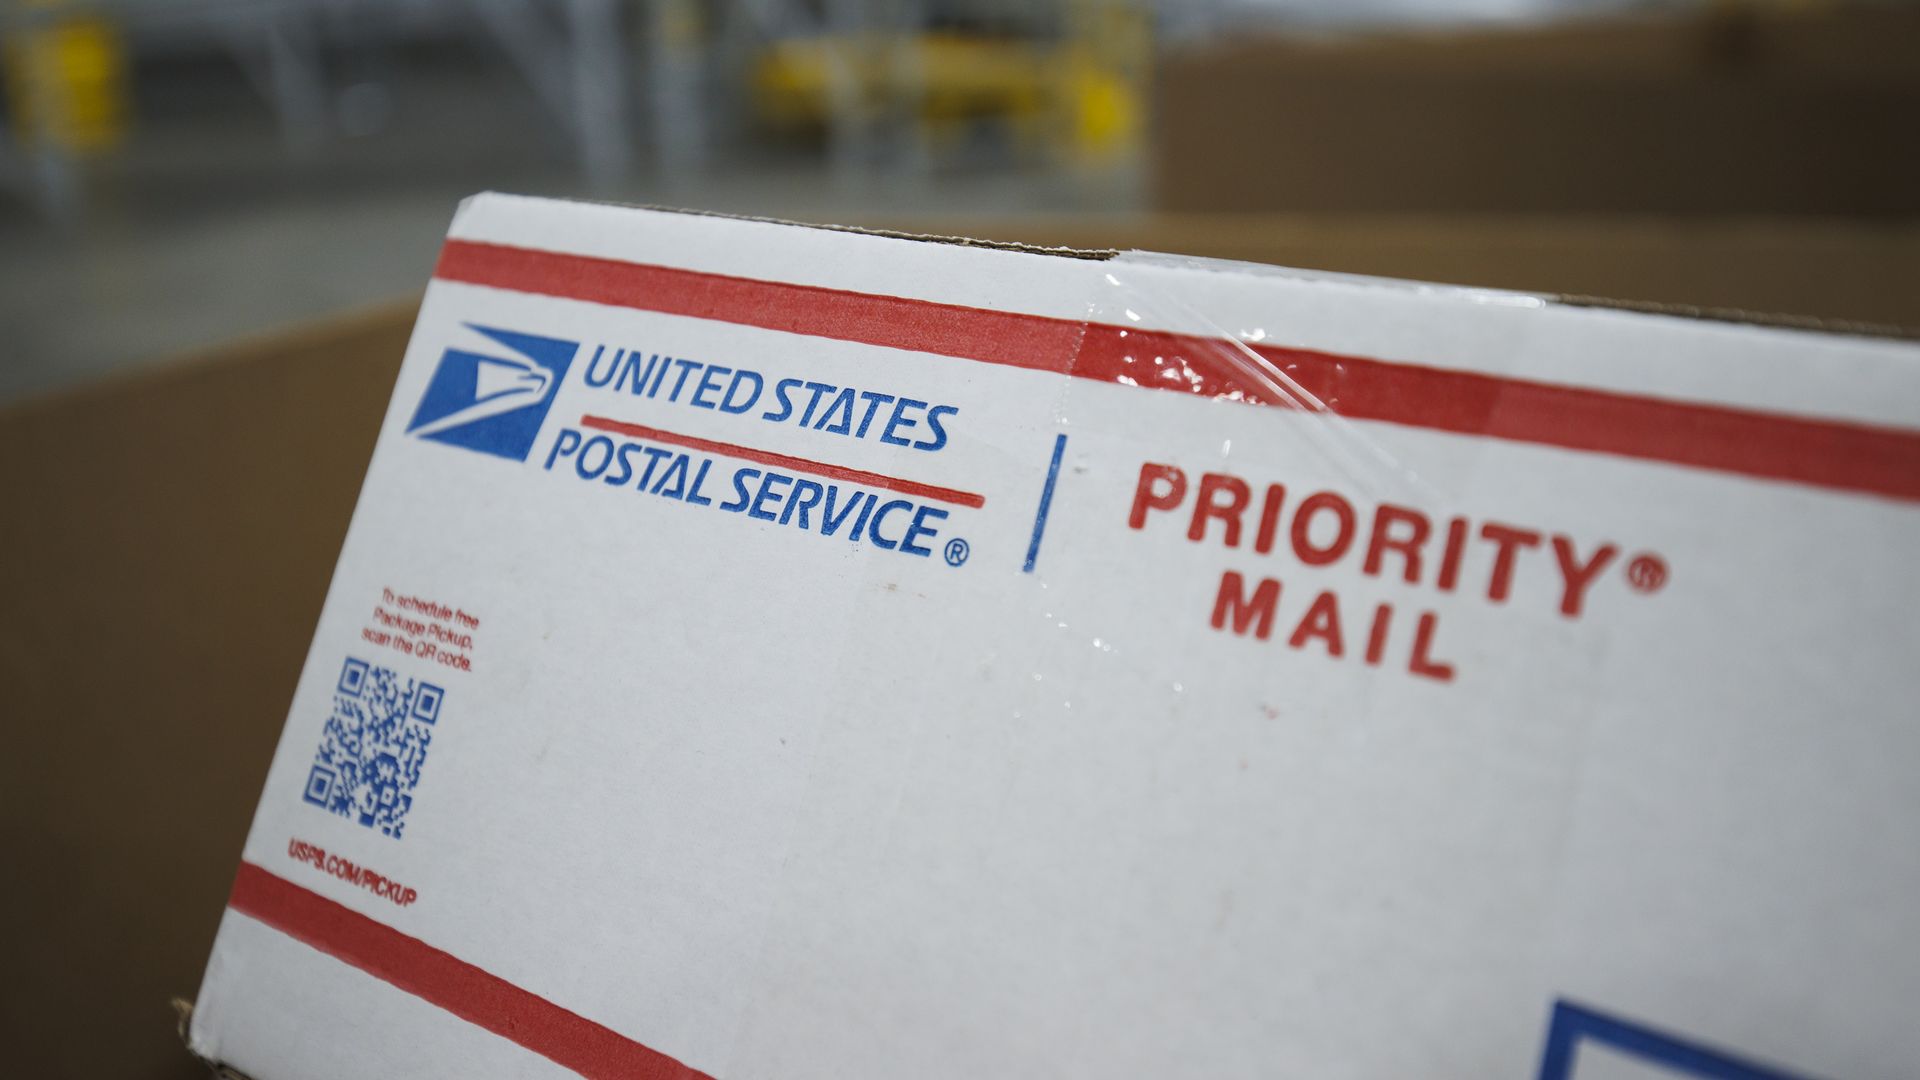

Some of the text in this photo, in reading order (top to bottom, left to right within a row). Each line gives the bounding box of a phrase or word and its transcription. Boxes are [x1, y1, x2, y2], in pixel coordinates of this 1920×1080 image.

[583, 345, 960, 453] UNITED STATES
[544, 428, 713, 507] POSTAL
[374, 607, 472, 649] Package Pickup,
[383, 586, 480, 629] To schedule free
[1211, 570, 1454, 682] MAIL
[361, 627, 472, 672] scan the QR code.
[288, 838, 417, 907] USPS.COM/PICKUP
